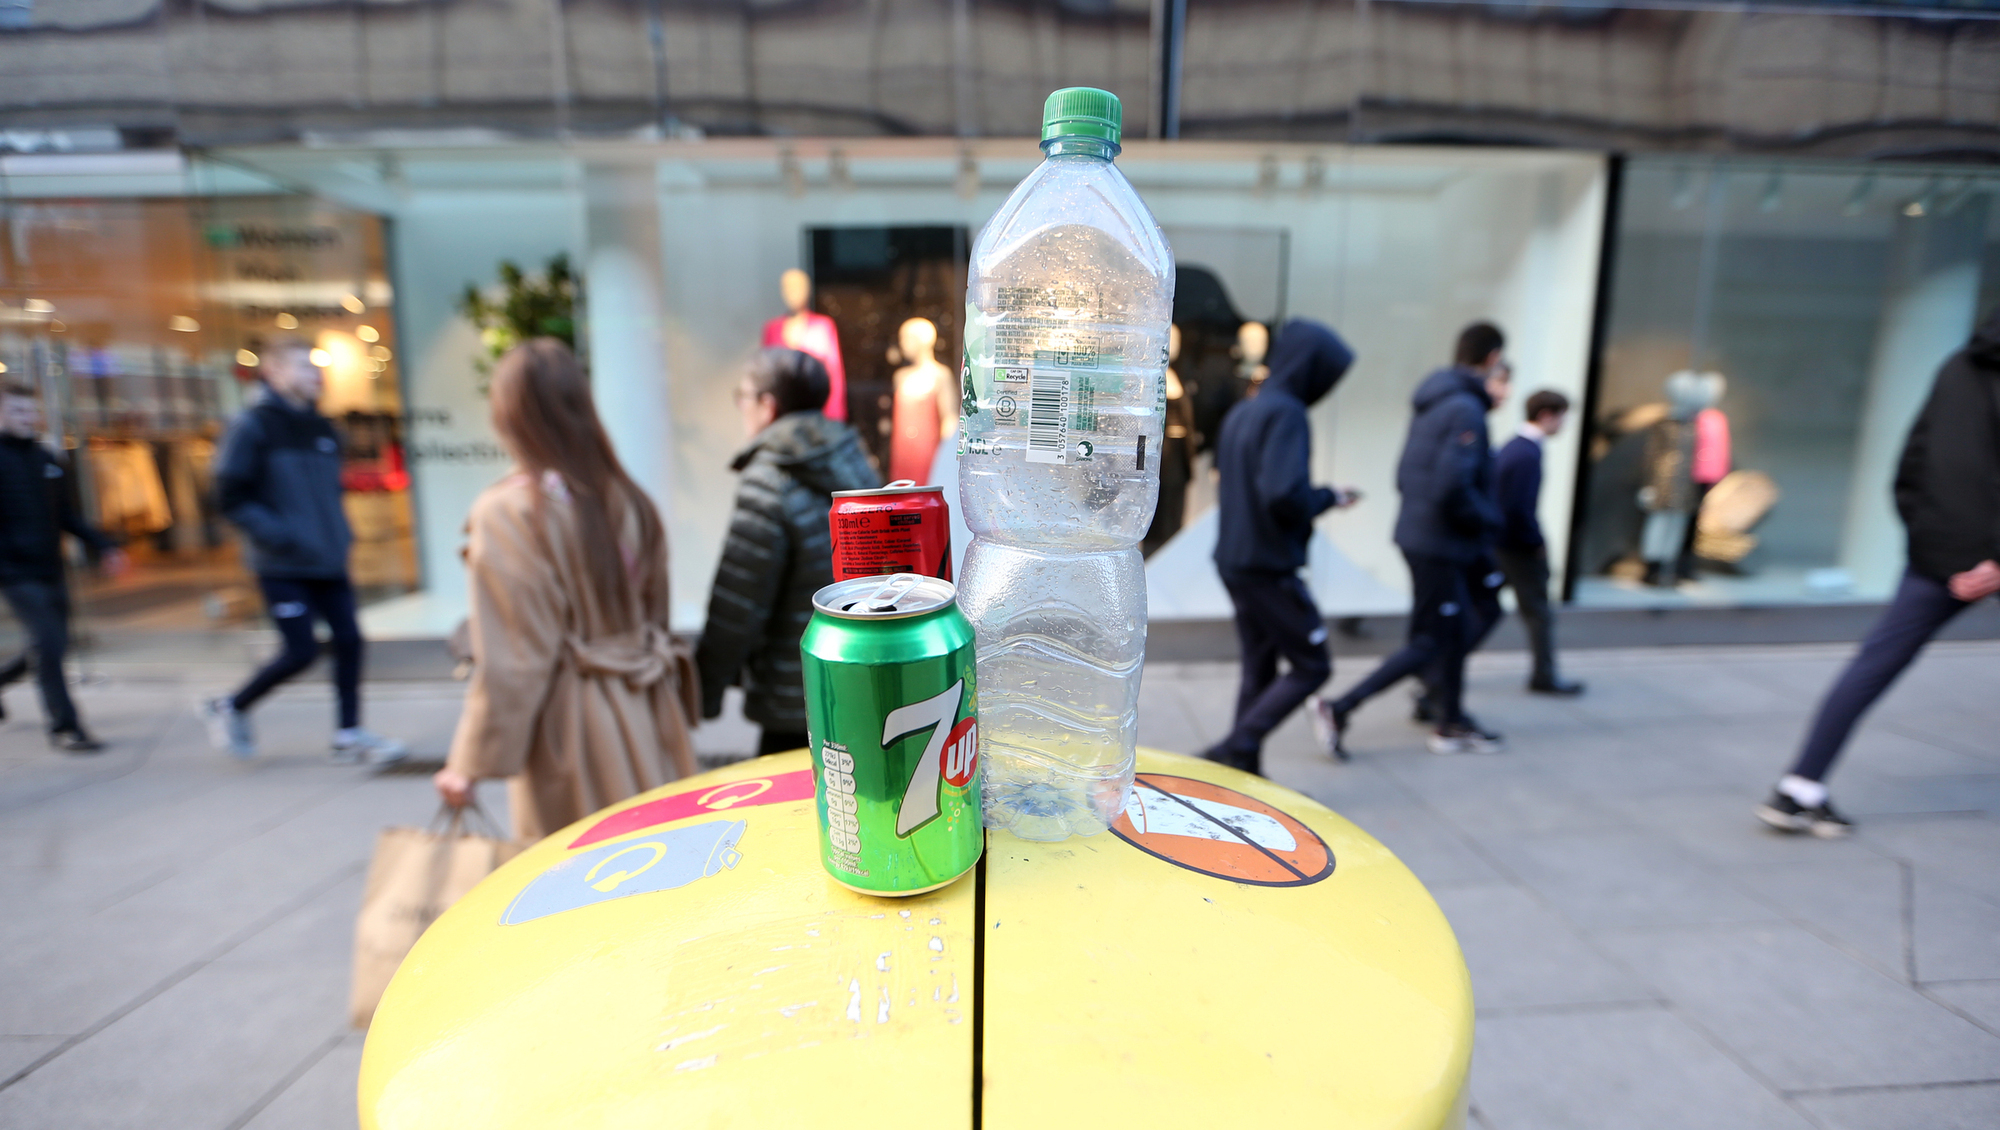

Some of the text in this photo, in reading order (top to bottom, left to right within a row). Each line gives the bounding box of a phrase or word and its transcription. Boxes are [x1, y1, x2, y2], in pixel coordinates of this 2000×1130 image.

[1061, 380, 1069, 412] 100178
[1058, 417, 1067, 449] 057640
[881, 677, 964, 838] 7
